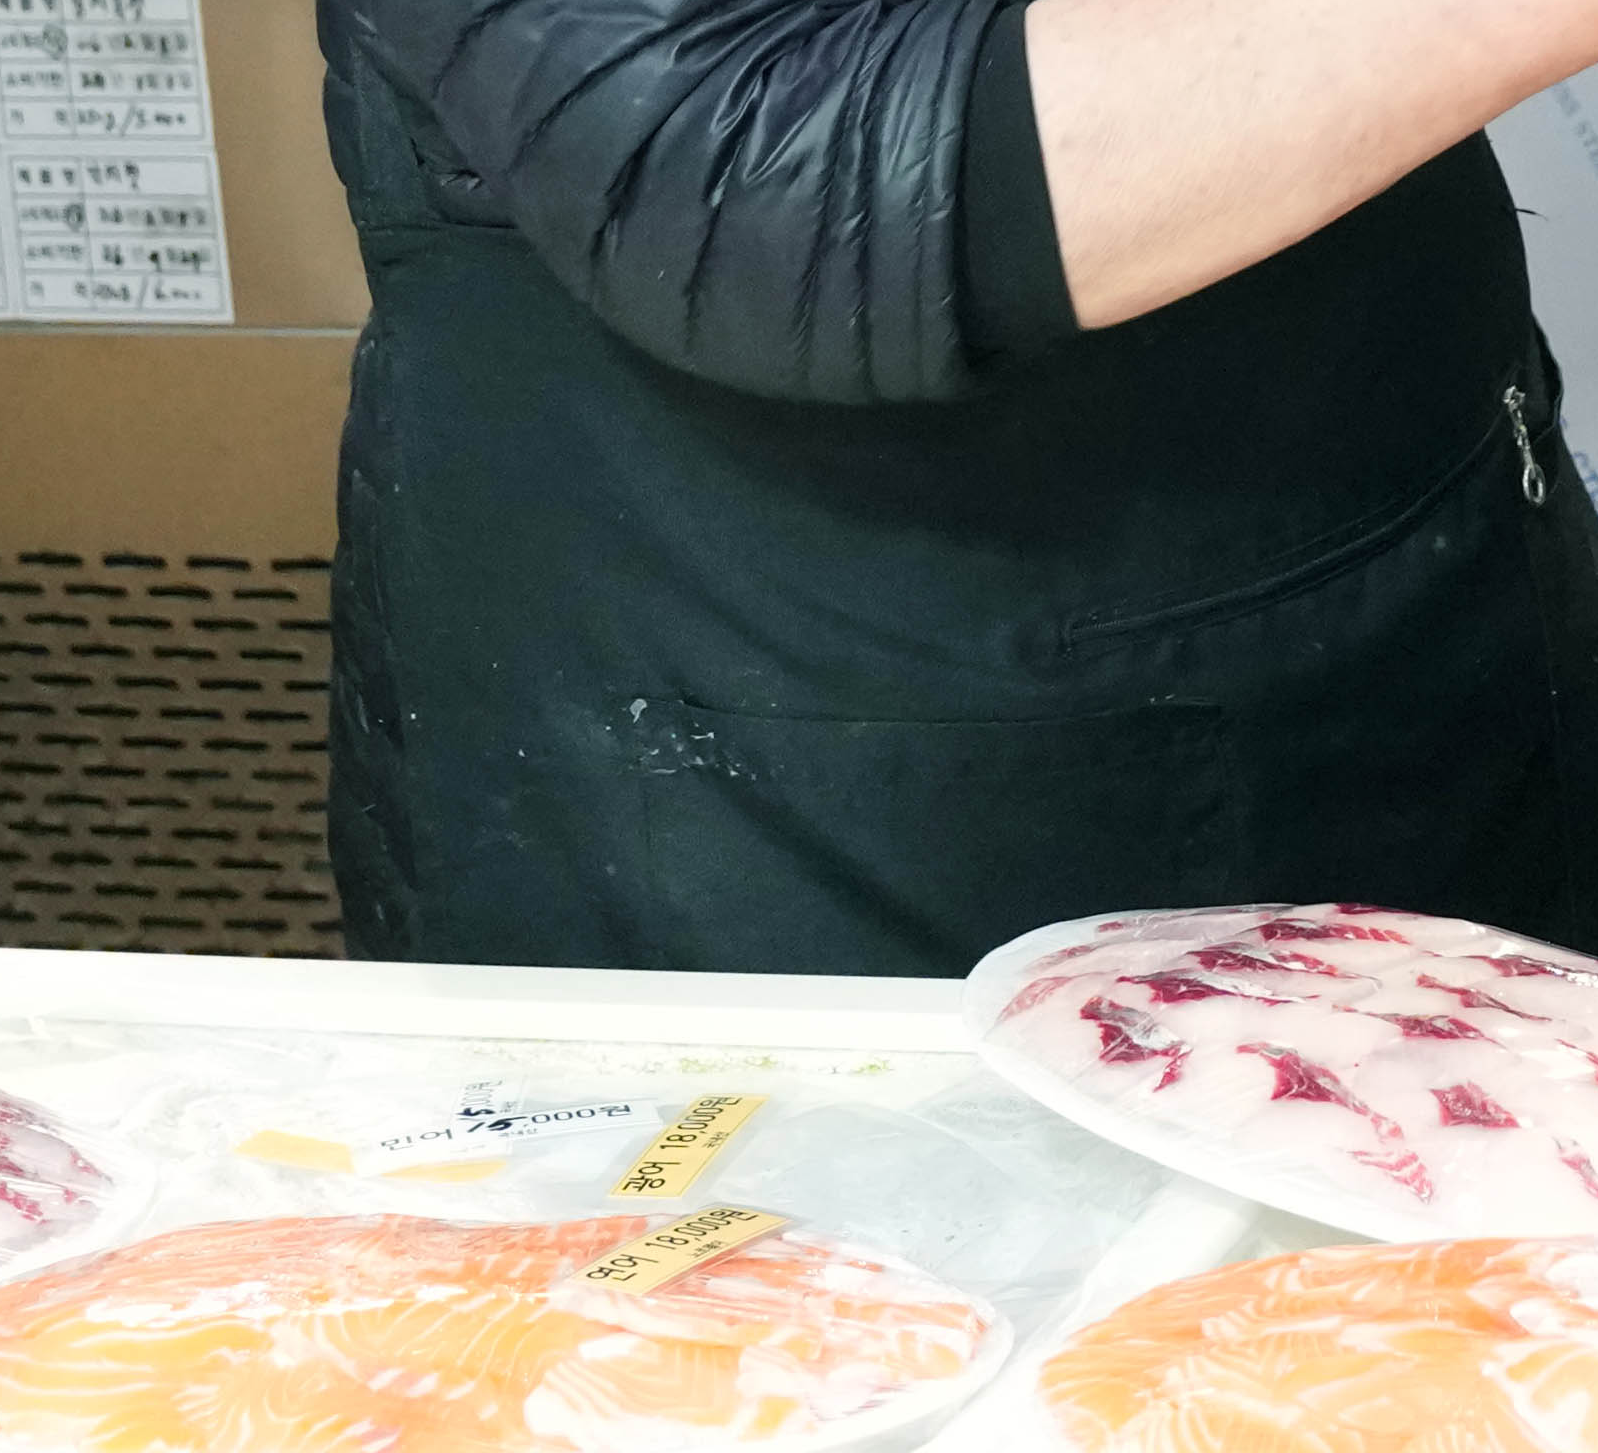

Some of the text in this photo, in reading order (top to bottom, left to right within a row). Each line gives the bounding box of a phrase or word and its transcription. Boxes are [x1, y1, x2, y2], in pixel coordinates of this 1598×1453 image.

[622, 1096, 743, 1193] 광어 18,000원
[586, 1253, 660, 1282] 연어
[644, 1208, 759, 1251] 18,000원
